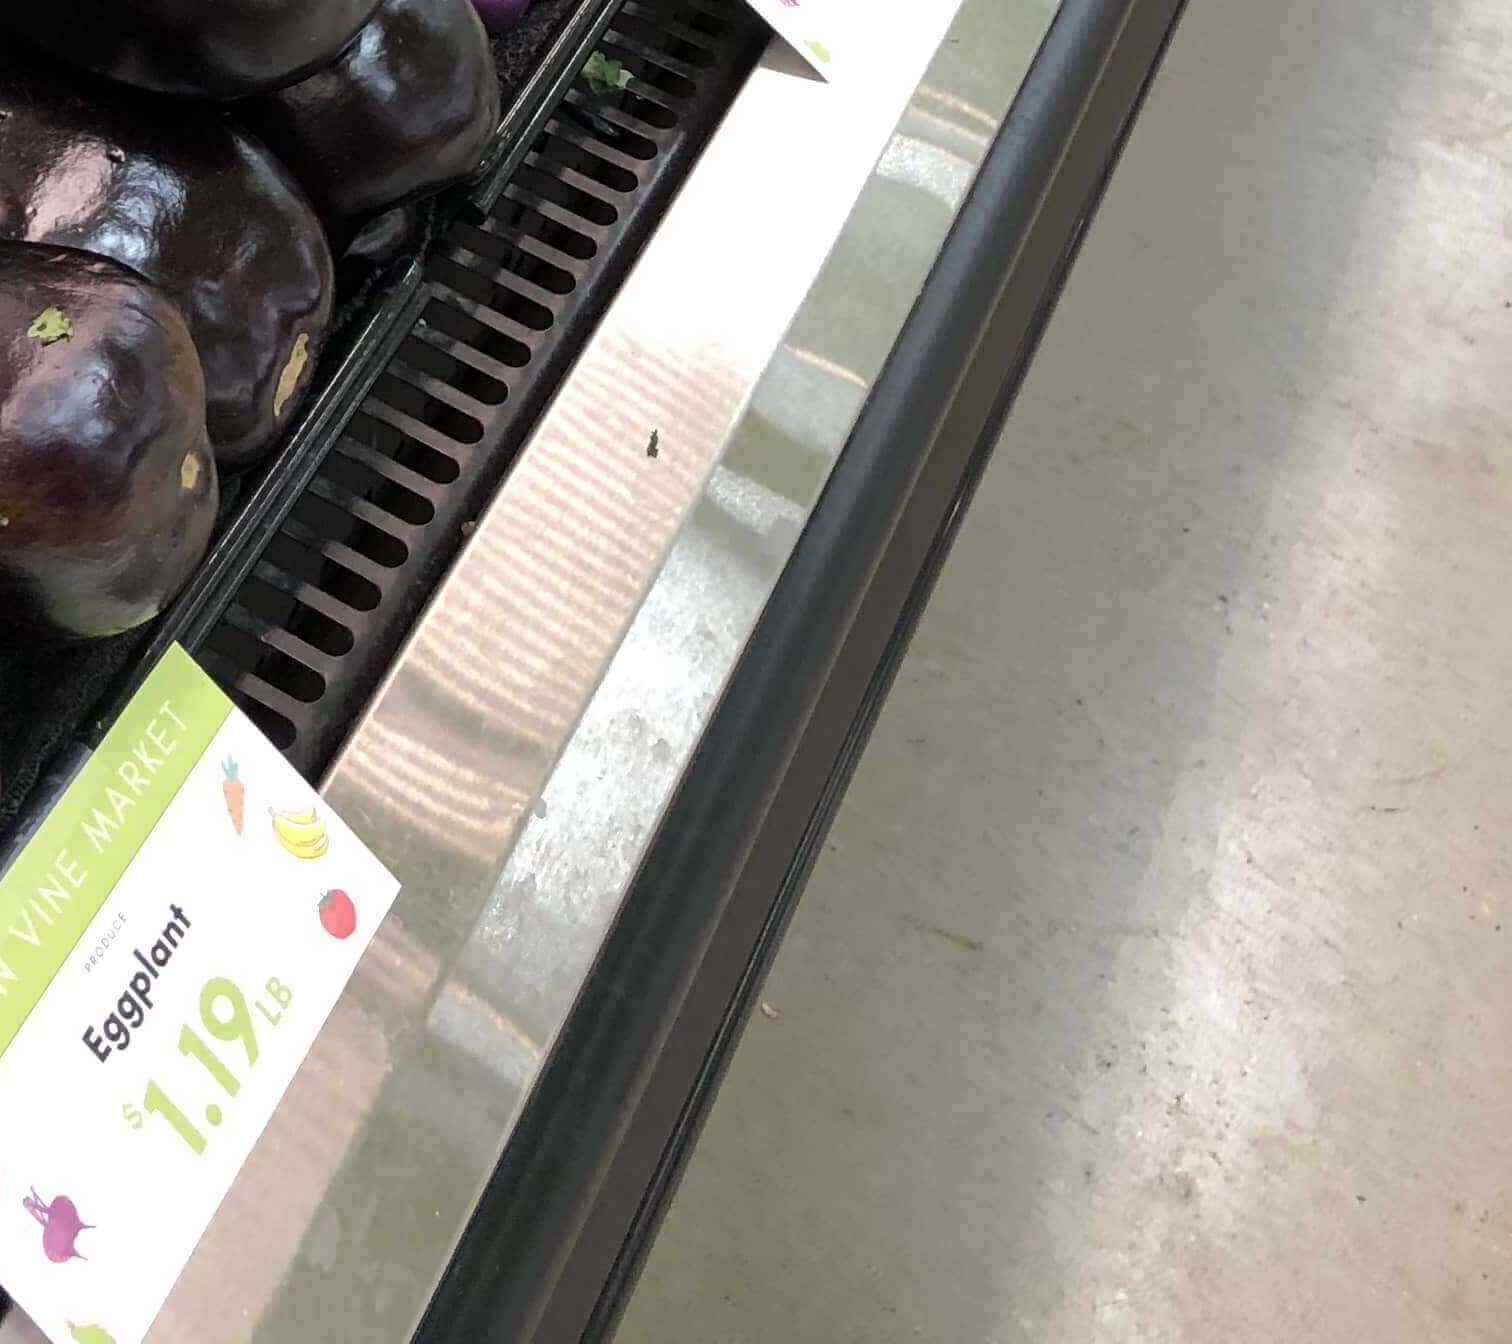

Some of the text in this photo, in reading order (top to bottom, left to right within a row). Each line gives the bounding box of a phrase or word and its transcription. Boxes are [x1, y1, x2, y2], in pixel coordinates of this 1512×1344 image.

[9, 865, 88, 948] VINE
[80, 700, 190, 854] MARKET
[81, 903, 191, 1063] Eggplant
[84, 912, 128, 973] PRODUCE
[255, 976, 292, 1026] LB
